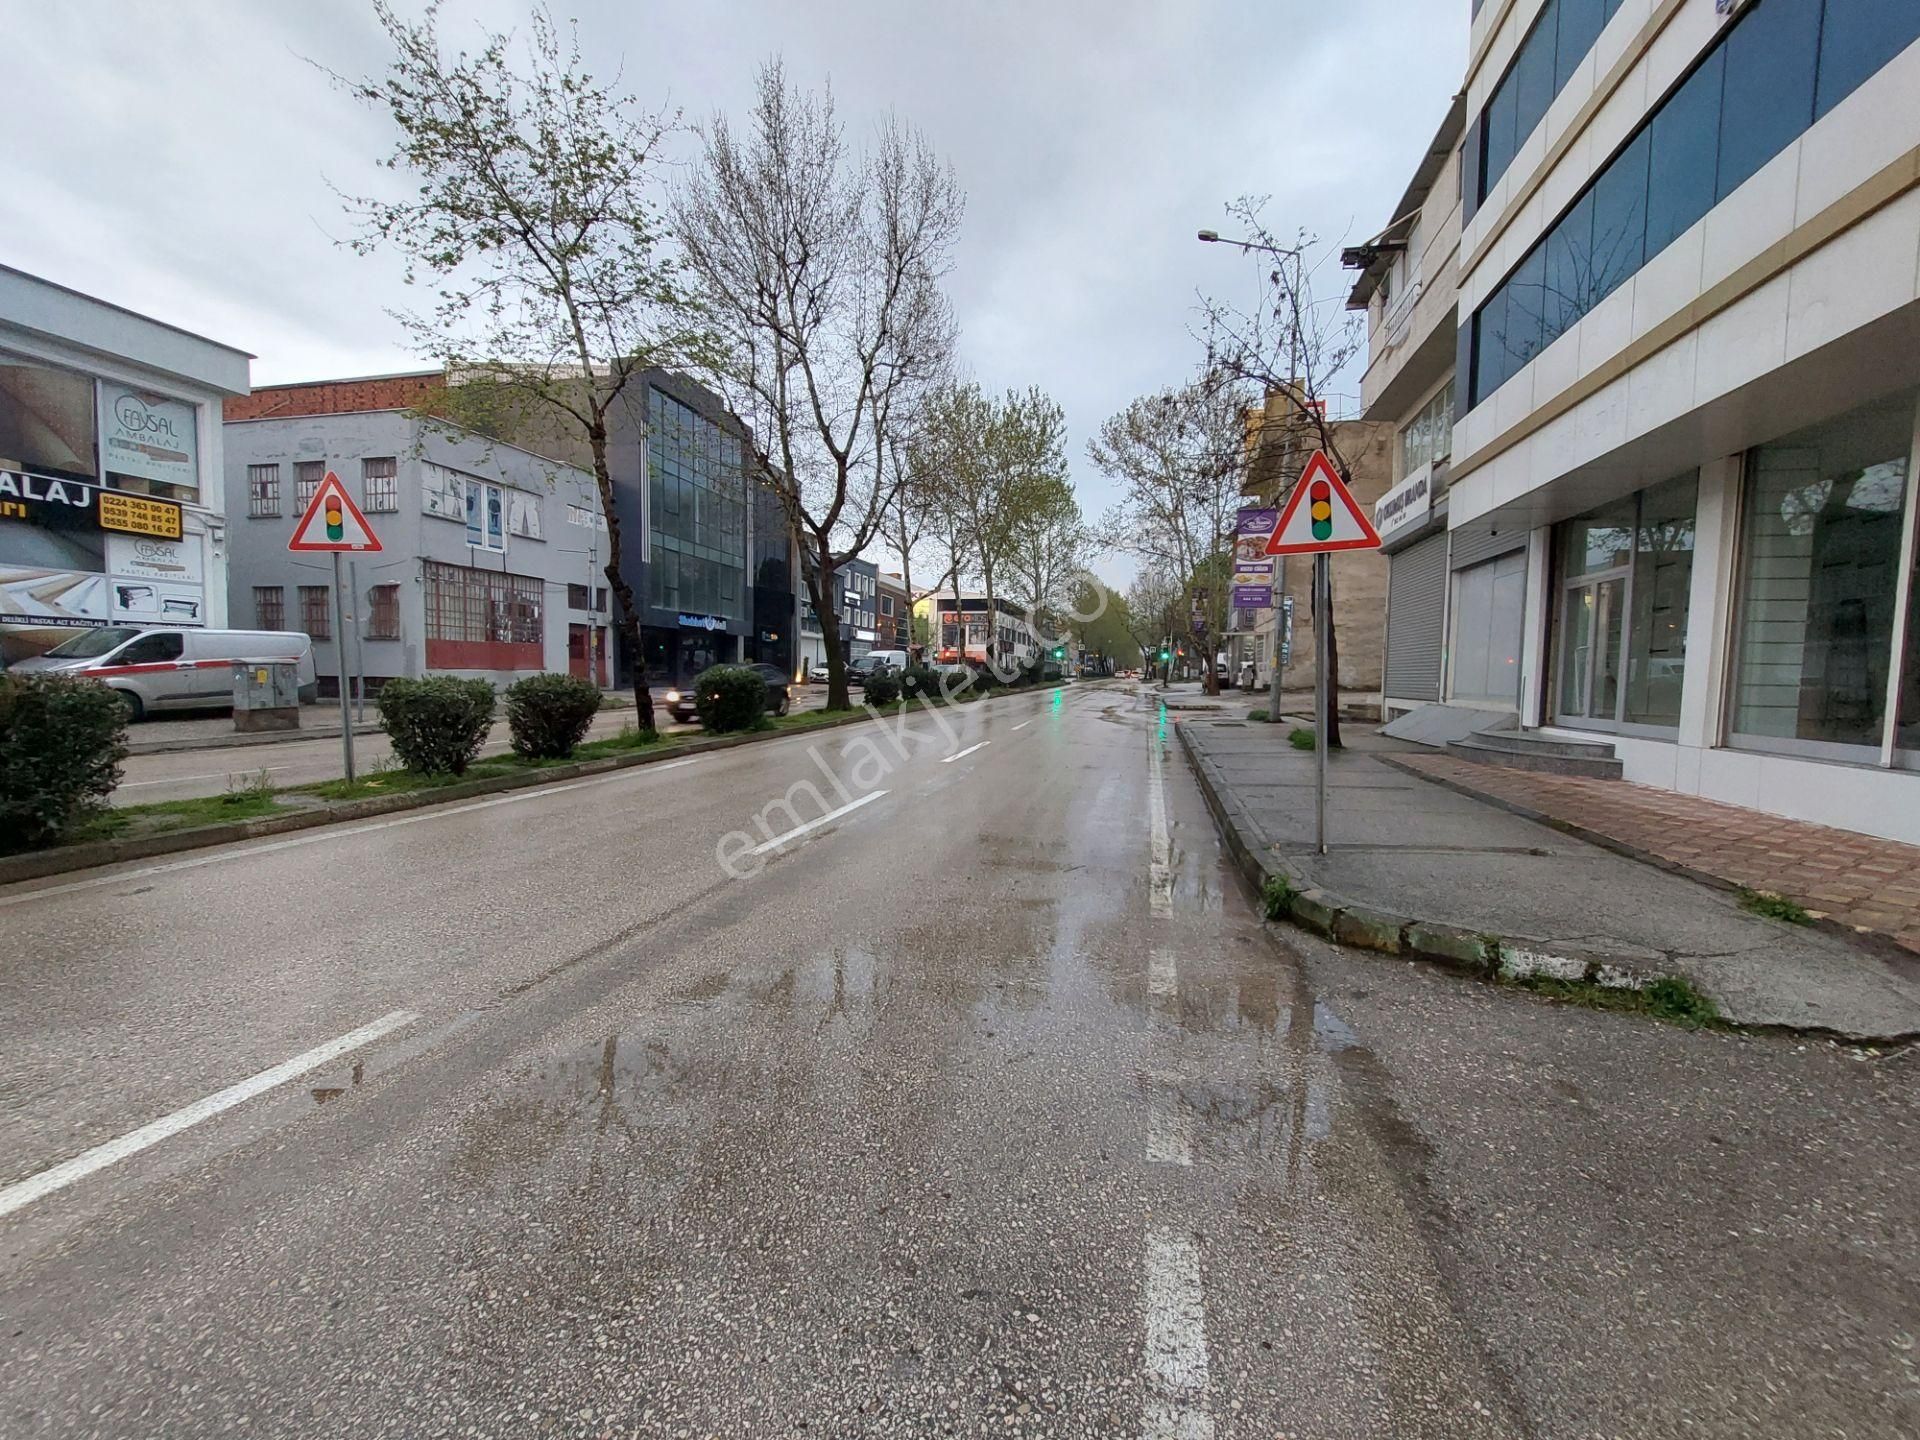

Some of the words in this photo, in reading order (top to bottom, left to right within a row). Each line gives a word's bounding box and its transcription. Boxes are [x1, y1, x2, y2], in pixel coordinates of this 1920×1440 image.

[111, 428, 179, 449] AMBALAJ
[103, 496, 128, 507] 0224
[164, 507, 176, 515] 47
[103, 516, 129, 528] 0555
[165, 526, 177, 535] 47
[165, 517, 176, 525] 47
